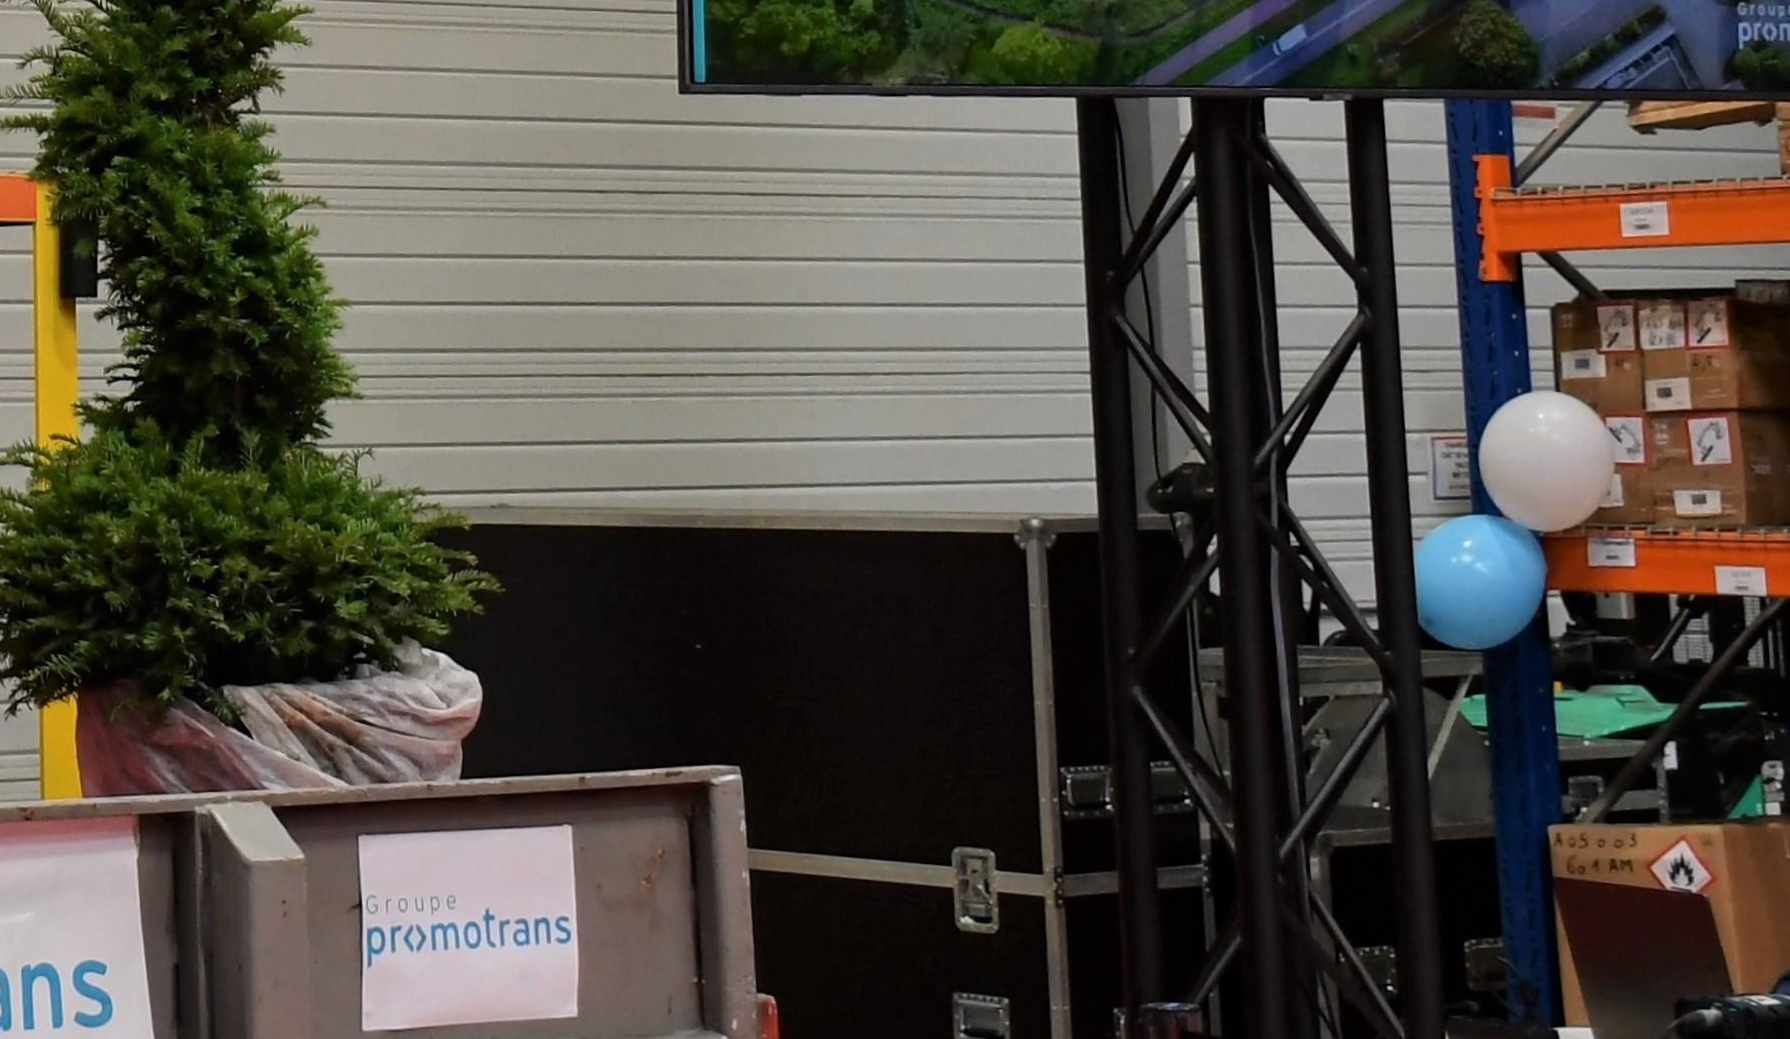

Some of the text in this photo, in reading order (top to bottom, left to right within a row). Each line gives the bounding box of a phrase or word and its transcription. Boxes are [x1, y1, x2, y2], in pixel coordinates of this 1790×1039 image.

[1737, 2, 1790, 18] Group
[365, 894, 457, 915] Groupe
[366, 907, 572, 968] promotrans
